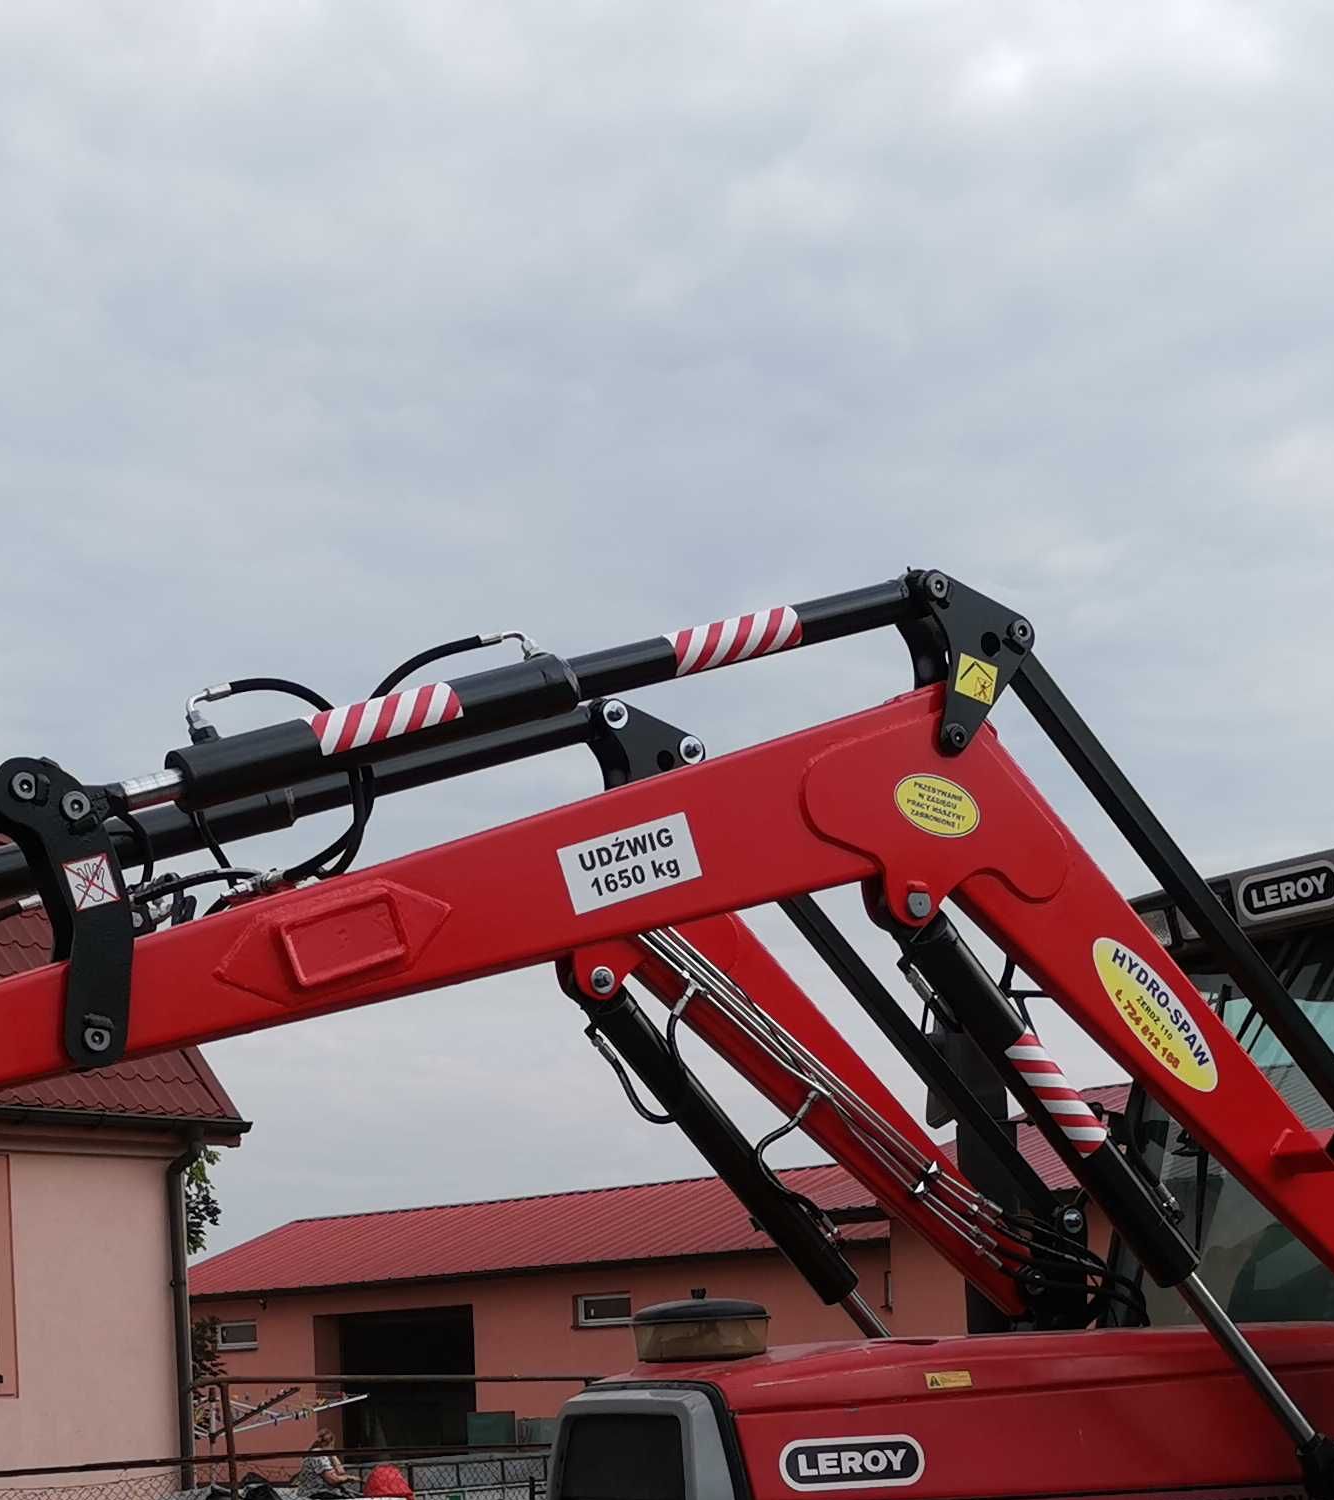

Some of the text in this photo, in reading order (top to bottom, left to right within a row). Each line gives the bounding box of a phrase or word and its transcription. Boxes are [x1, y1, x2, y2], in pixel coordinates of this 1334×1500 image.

[578, 827, 674, 872] UDŹWIG
[591, 857, 680, 897] 1650 kg
[1251, 872, 1328, 909] LEROY
[1111, 948, 1210, 1067] HYDRO-SPAW
[797, 1448, 907, 1477] LEROY
